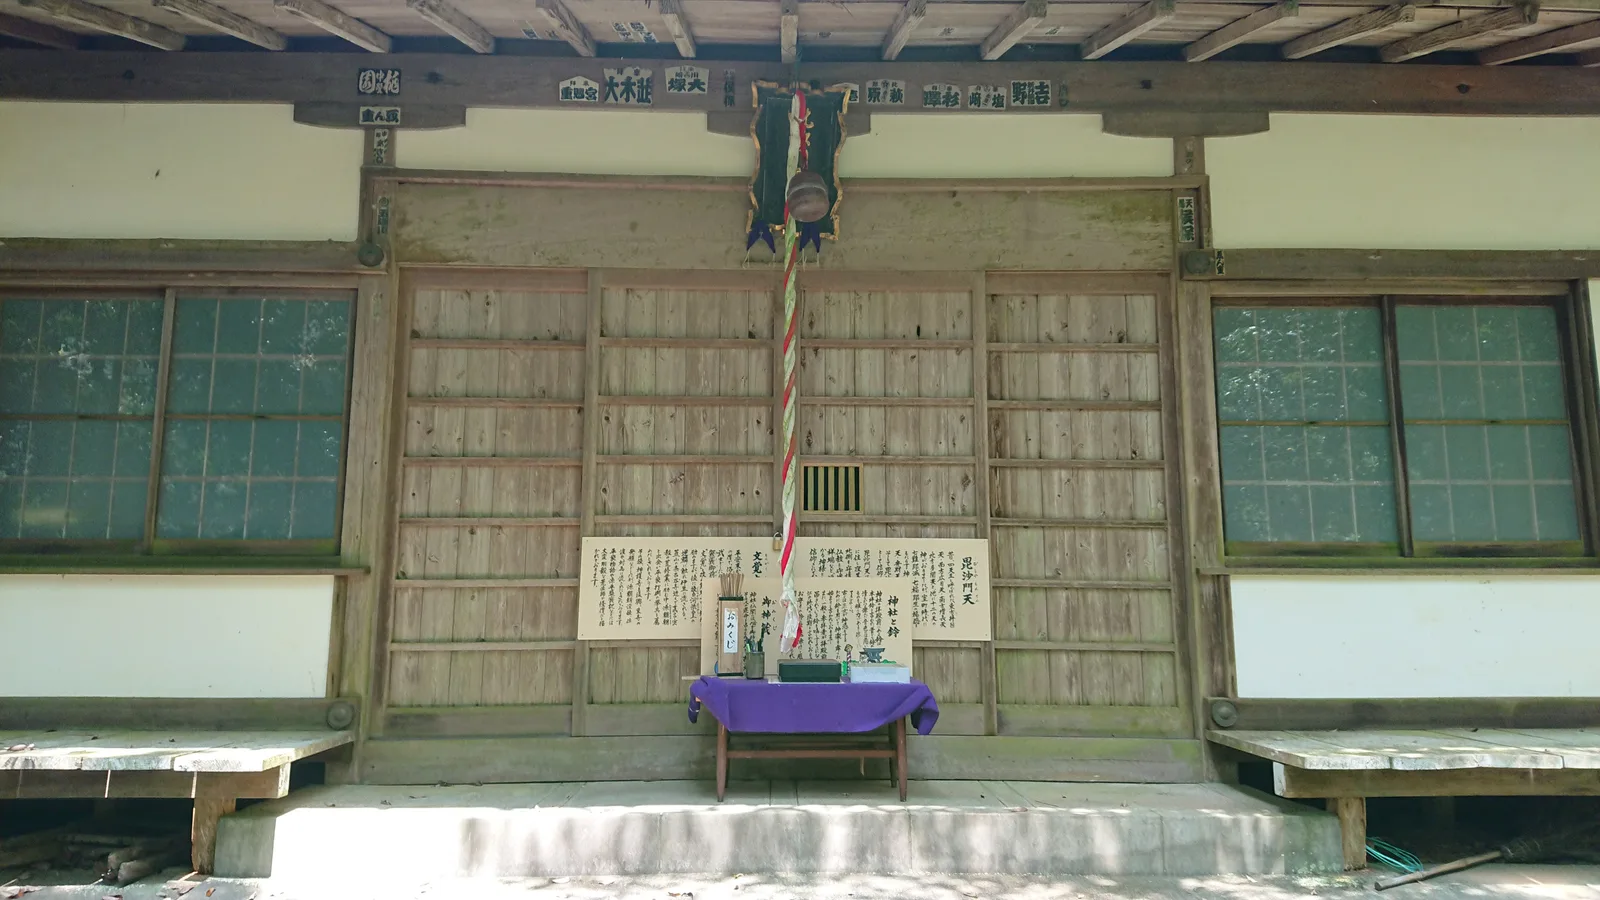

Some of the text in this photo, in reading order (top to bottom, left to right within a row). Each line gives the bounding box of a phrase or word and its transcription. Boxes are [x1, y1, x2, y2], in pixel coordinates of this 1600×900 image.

[961, 556, 975, 605] 毘沙門天
[726, 612, 736, 650] おみくじ
[887, 595, 900, 638] 神社と鈴
